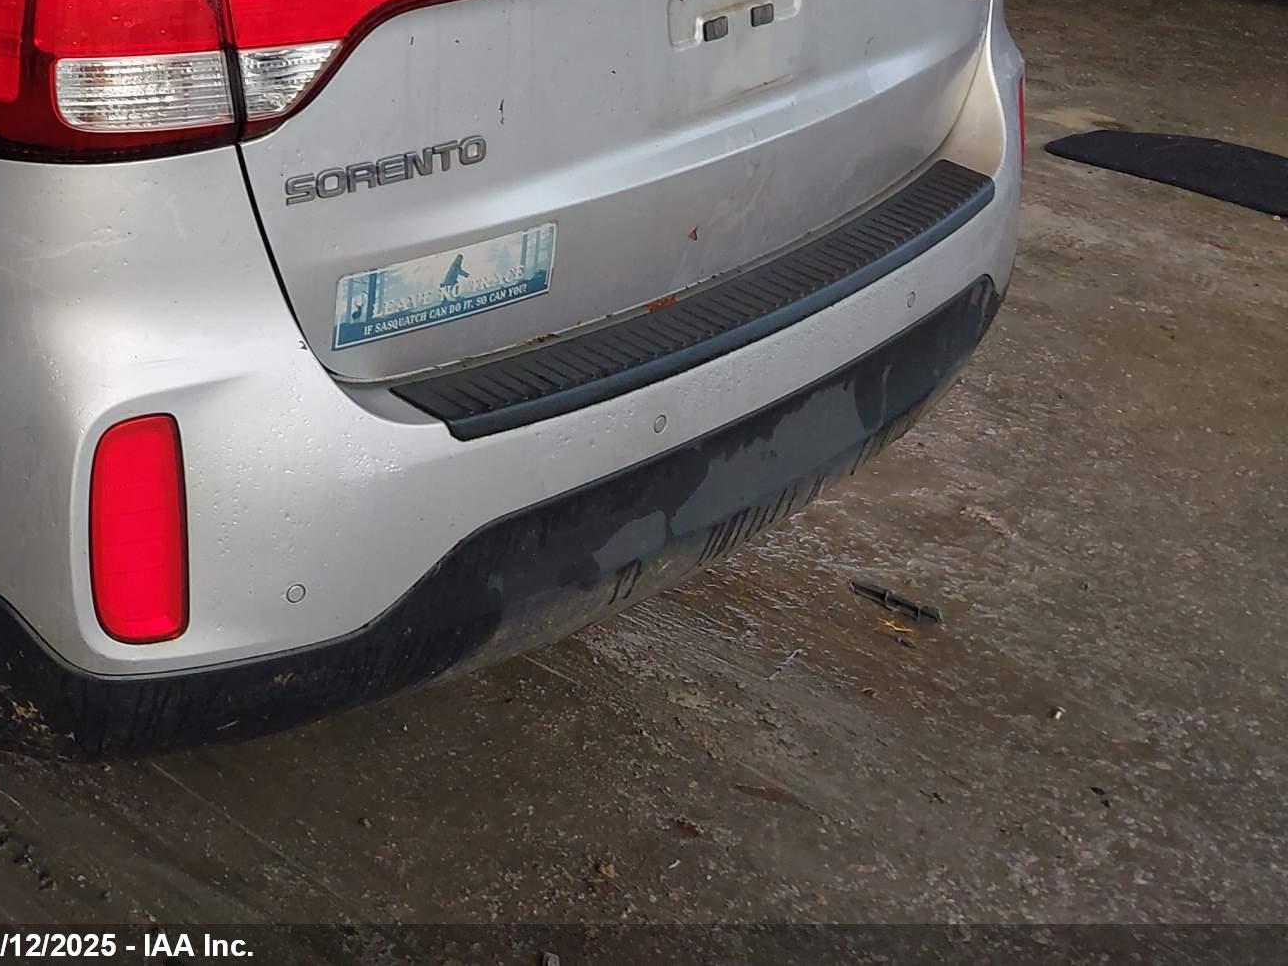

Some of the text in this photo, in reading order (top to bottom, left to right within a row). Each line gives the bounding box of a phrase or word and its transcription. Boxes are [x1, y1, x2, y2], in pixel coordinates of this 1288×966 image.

[285, 135, 487, 206] SORENTO
[363, 324, 374, 335] IF
[374, 312, 427, 333] SASQUATCH
[429, 305, 448, 319] CAN
[449, 303, 462, 314] DO
[476, 295, 488, 307] SO
[488, 289, 507, 303] CAN
[372, 289, 434, 318] LEAVE
[439, 283, 460, 302] NO
